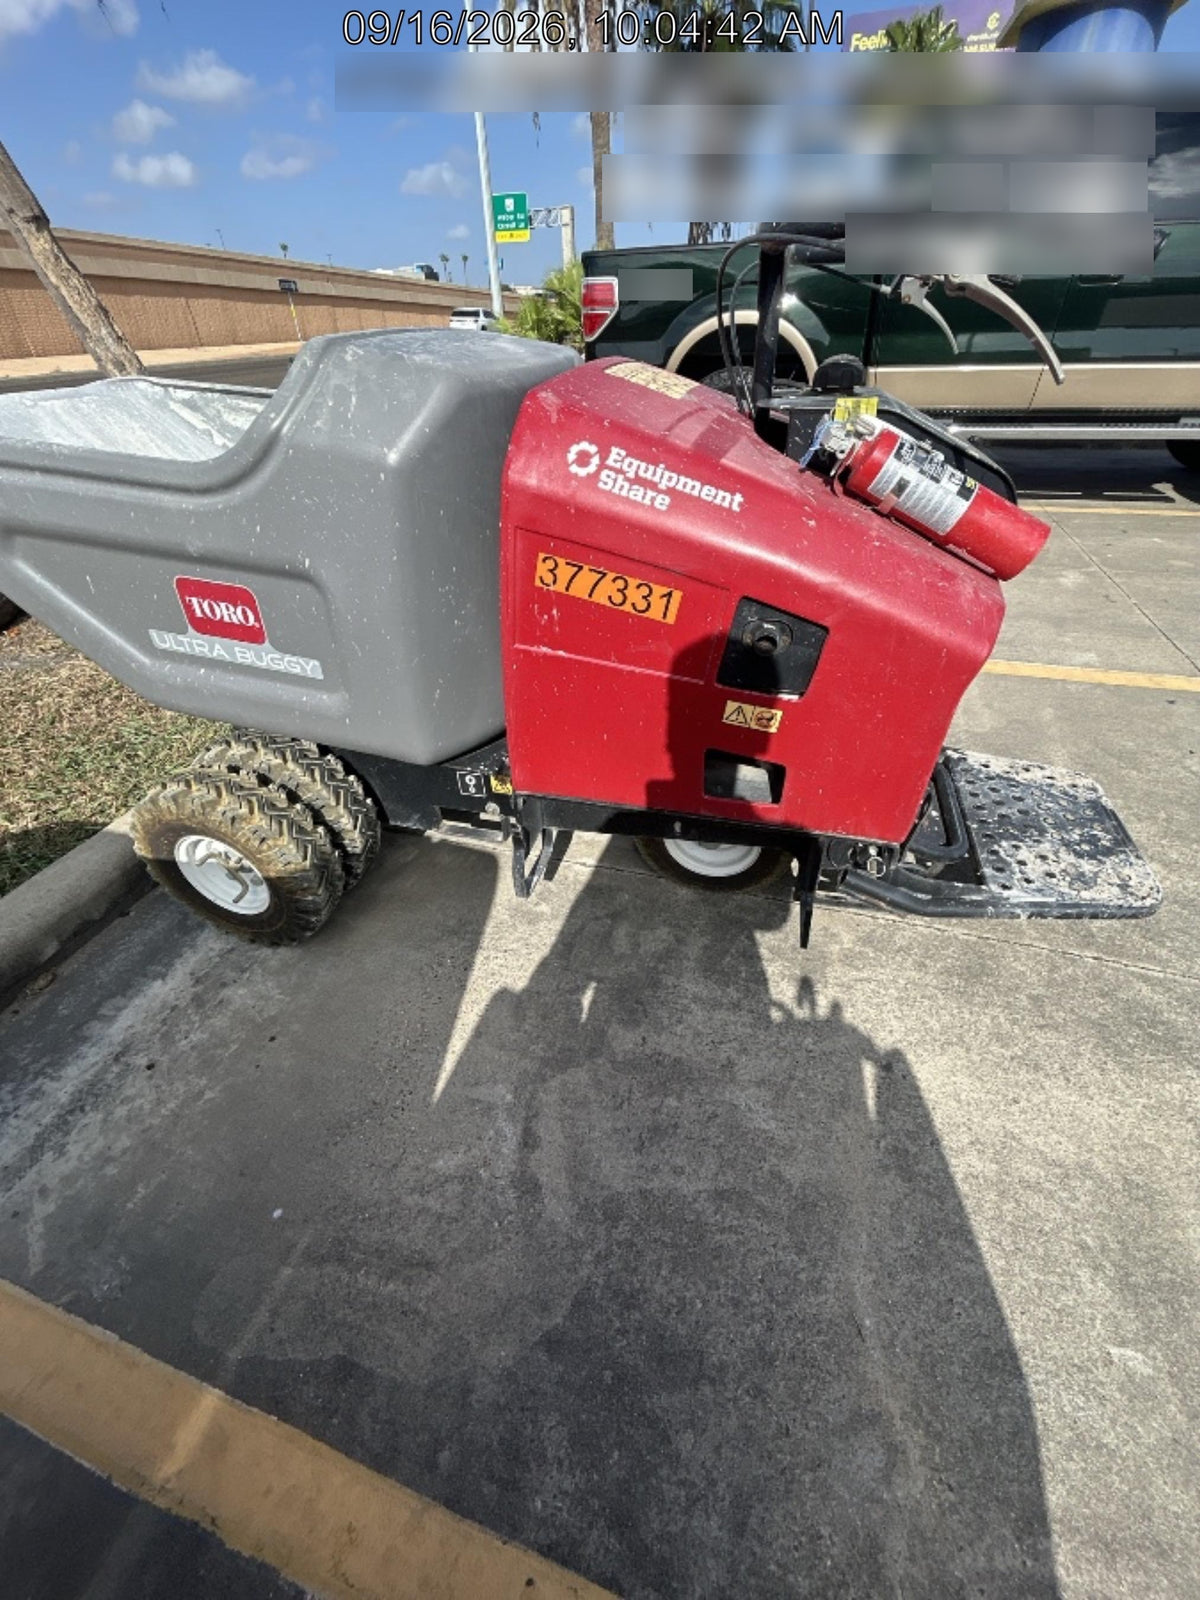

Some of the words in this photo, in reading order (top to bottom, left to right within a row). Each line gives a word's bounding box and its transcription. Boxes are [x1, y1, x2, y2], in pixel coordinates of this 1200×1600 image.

[598, 468, 671, 511] Share
[605, 446, 744, 512] Equipment
[538, 556, 674, 620] 377331
[152, 632, 228, 659] ULTRA
[234, 646, 319, 675] BUGGY
